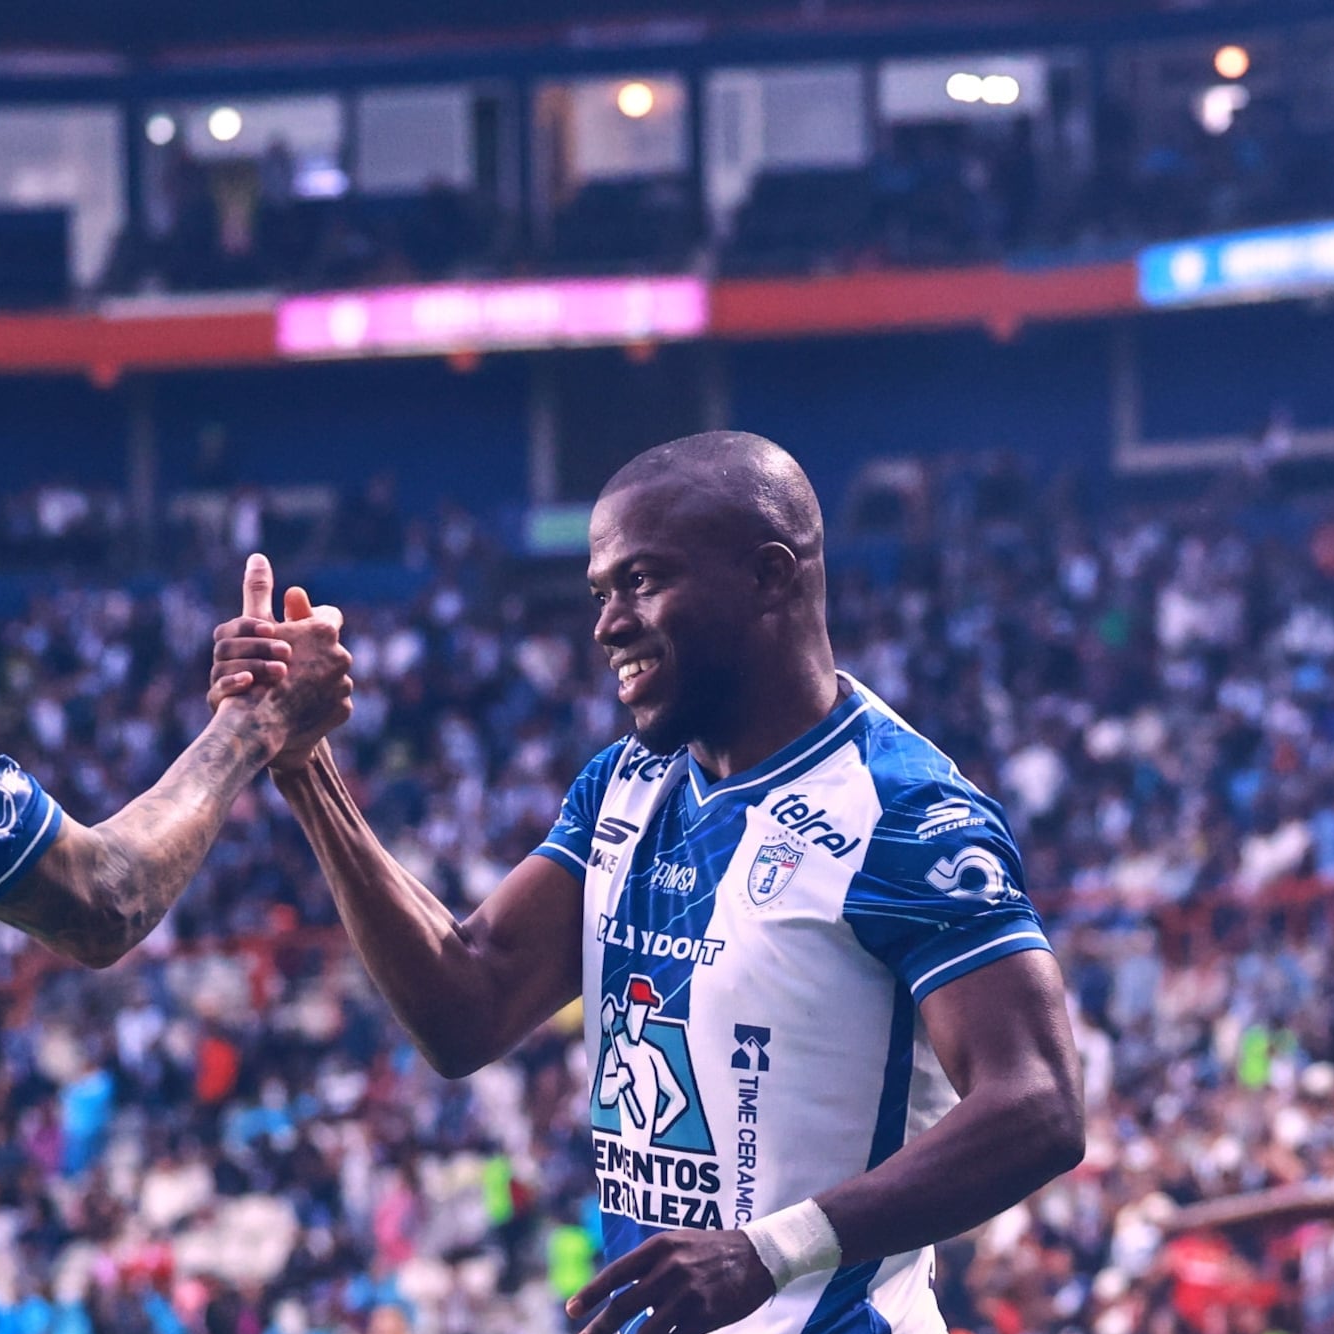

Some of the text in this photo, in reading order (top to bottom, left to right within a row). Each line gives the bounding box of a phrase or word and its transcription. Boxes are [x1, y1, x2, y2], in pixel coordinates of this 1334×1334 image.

[770, 793, 862, 859] telcel
[918, 817, 987, 841] SKECHERS
[735, 1075, 759, 1231] TIME CERAMIC
